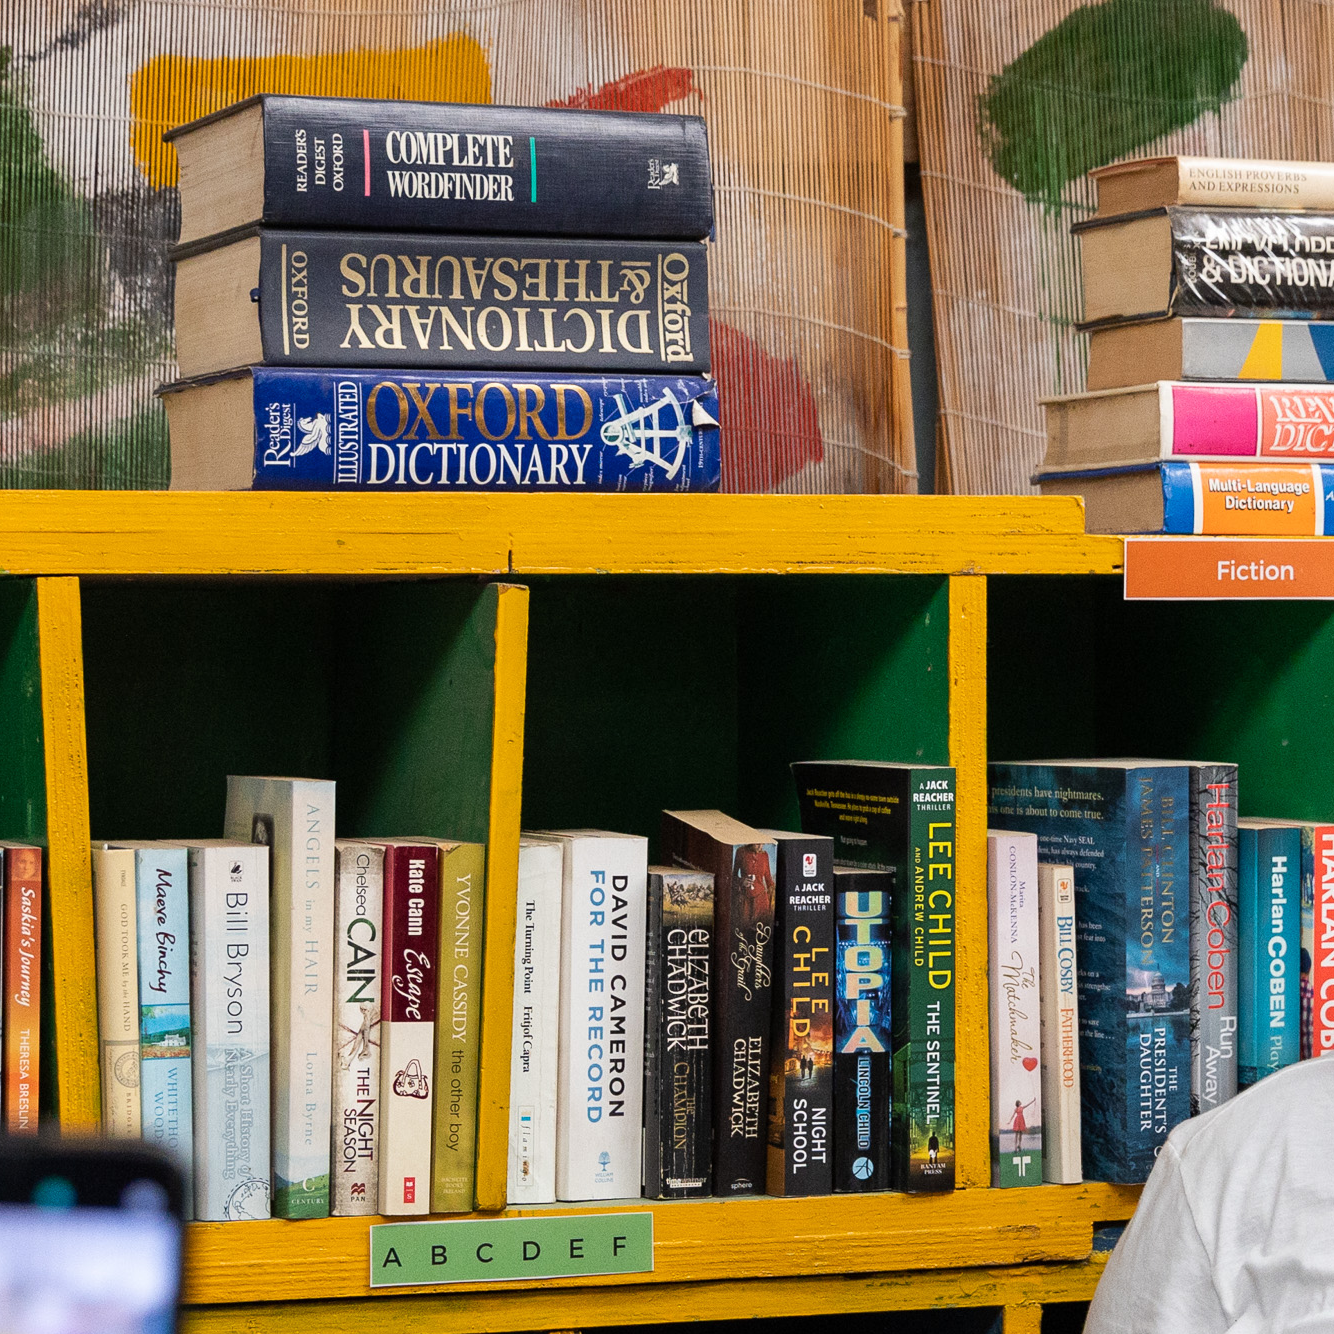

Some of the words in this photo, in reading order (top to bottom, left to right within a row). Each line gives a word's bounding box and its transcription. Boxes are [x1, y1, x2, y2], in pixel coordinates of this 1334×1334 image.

[296, 128, 307, 192] READER'S
[314, 136, 325, 185] DIGEST
[333, 133, 344, 192] OXFORD
[385, 130, 514, 168] COMPLETE
[387, 170, 515, 202] WORDFINDER
[291, 251, 310, 349] OXFORD
[663, 252, 694, 363] Oxford
[339, 304, 654, 354] DICTIONARY
[338, 381, 359, 484] ILLUSTRATED
[367, 381, 593, 441] OXFORD
[367, 443, 593, 486] DICTIONARY
[1208, 478, 1311, 496] Multi-Language
[1225, 496, 1295, 514] Dictionary
[1217, 560, 1295, 582] Fiction
[913, 792, 954, 802] REACHER
[991, 788, 1032, 799] presidents
[1035, 788, 1051, 798] have
[1055, 788, 1104, 802] nightmares.
[928, 822, 952, 880] LEE
[1206, 783, 1230, 892] Harlan
[355, 854, 370, 916] Chelsea
[409, 858, 425, 894] Kate
[589, 870, 605, 926] FOR
[789, 894, 831, 905] REACHER
[915, 866, 924, 922] ANDREW
[19, 886, 37, 948] Saskia's
[226, 893, 249, 932] Bill
[409, 900, 425, 936] Cann
[454, 874, 471, 962] YVONNE
[527, 900, 535, 922] The
[609, 875, 629, 961] DAVID
[347, 918, 377, 1004] CAIN
[525, 924, 535, 964] Turning
[589, 939, 605, 992] THE
[914, 930, 923, 967] CHILD
[928, 890, 951, 990] CHILD
[1206, 900, 1231, 1010] Coben
[15, 950, 33, 1008] Journey
[223, 944, 249, 1034] Bryson
[452, 964, 469, 1044] CASSIDY
[668, 930, 687, 1051] CHADWICK
[793, 926, 811, 1038] CHILD
[812, 948, 829, 1013] LEE
[523, 1006, 533, 1041] Fritjof
[609, 971, 627, 1117] CAMERON
[926, 1001, 940, 1035] THE
[19, 1028, 30, 1080] THERESA
[452, 1050, 463, 1072] the
[521, 1044, 531, 1074] Capra
[587, 1006, 605, 1123] RECORD
[1060, 1008, 1074, 1088] FATHERHOOD
[19, 1084, 30, 1130] BRESLIN
[357, 1068, 370, 1096] THE
[449, 1077, 463, 1120] other
[731, 1039, 747, 1138] CHADWICK
[746, 1036, 762, 1138] ELIZABETH
[926, 1040, 940, 1124] SENTINEL
[1140, 1034, 1153, 1132] DAUGHTER
[1154, 1027, 1167, 1134] PRESIDENT'S
[1169, 1066, 1178, 1092] THE
[343, 1108, 357, 1173] SEASON
[356, 1098, 374, 1160] NIGHT
[446, 1124, 461, 1152] boy
[793, 1098, 807, 1174] SCHOOL
[811, 1108, 827, 1164] NIGHT
[383, 1248, 402, 1268] A
[431, 1246, 447, 1265] B
[477, 1243, 493, 1262] C
[523, 1241, 541, 1260] D
[570, 1238, 584, 1258] E
[613, 1236, 626, 1256] F
